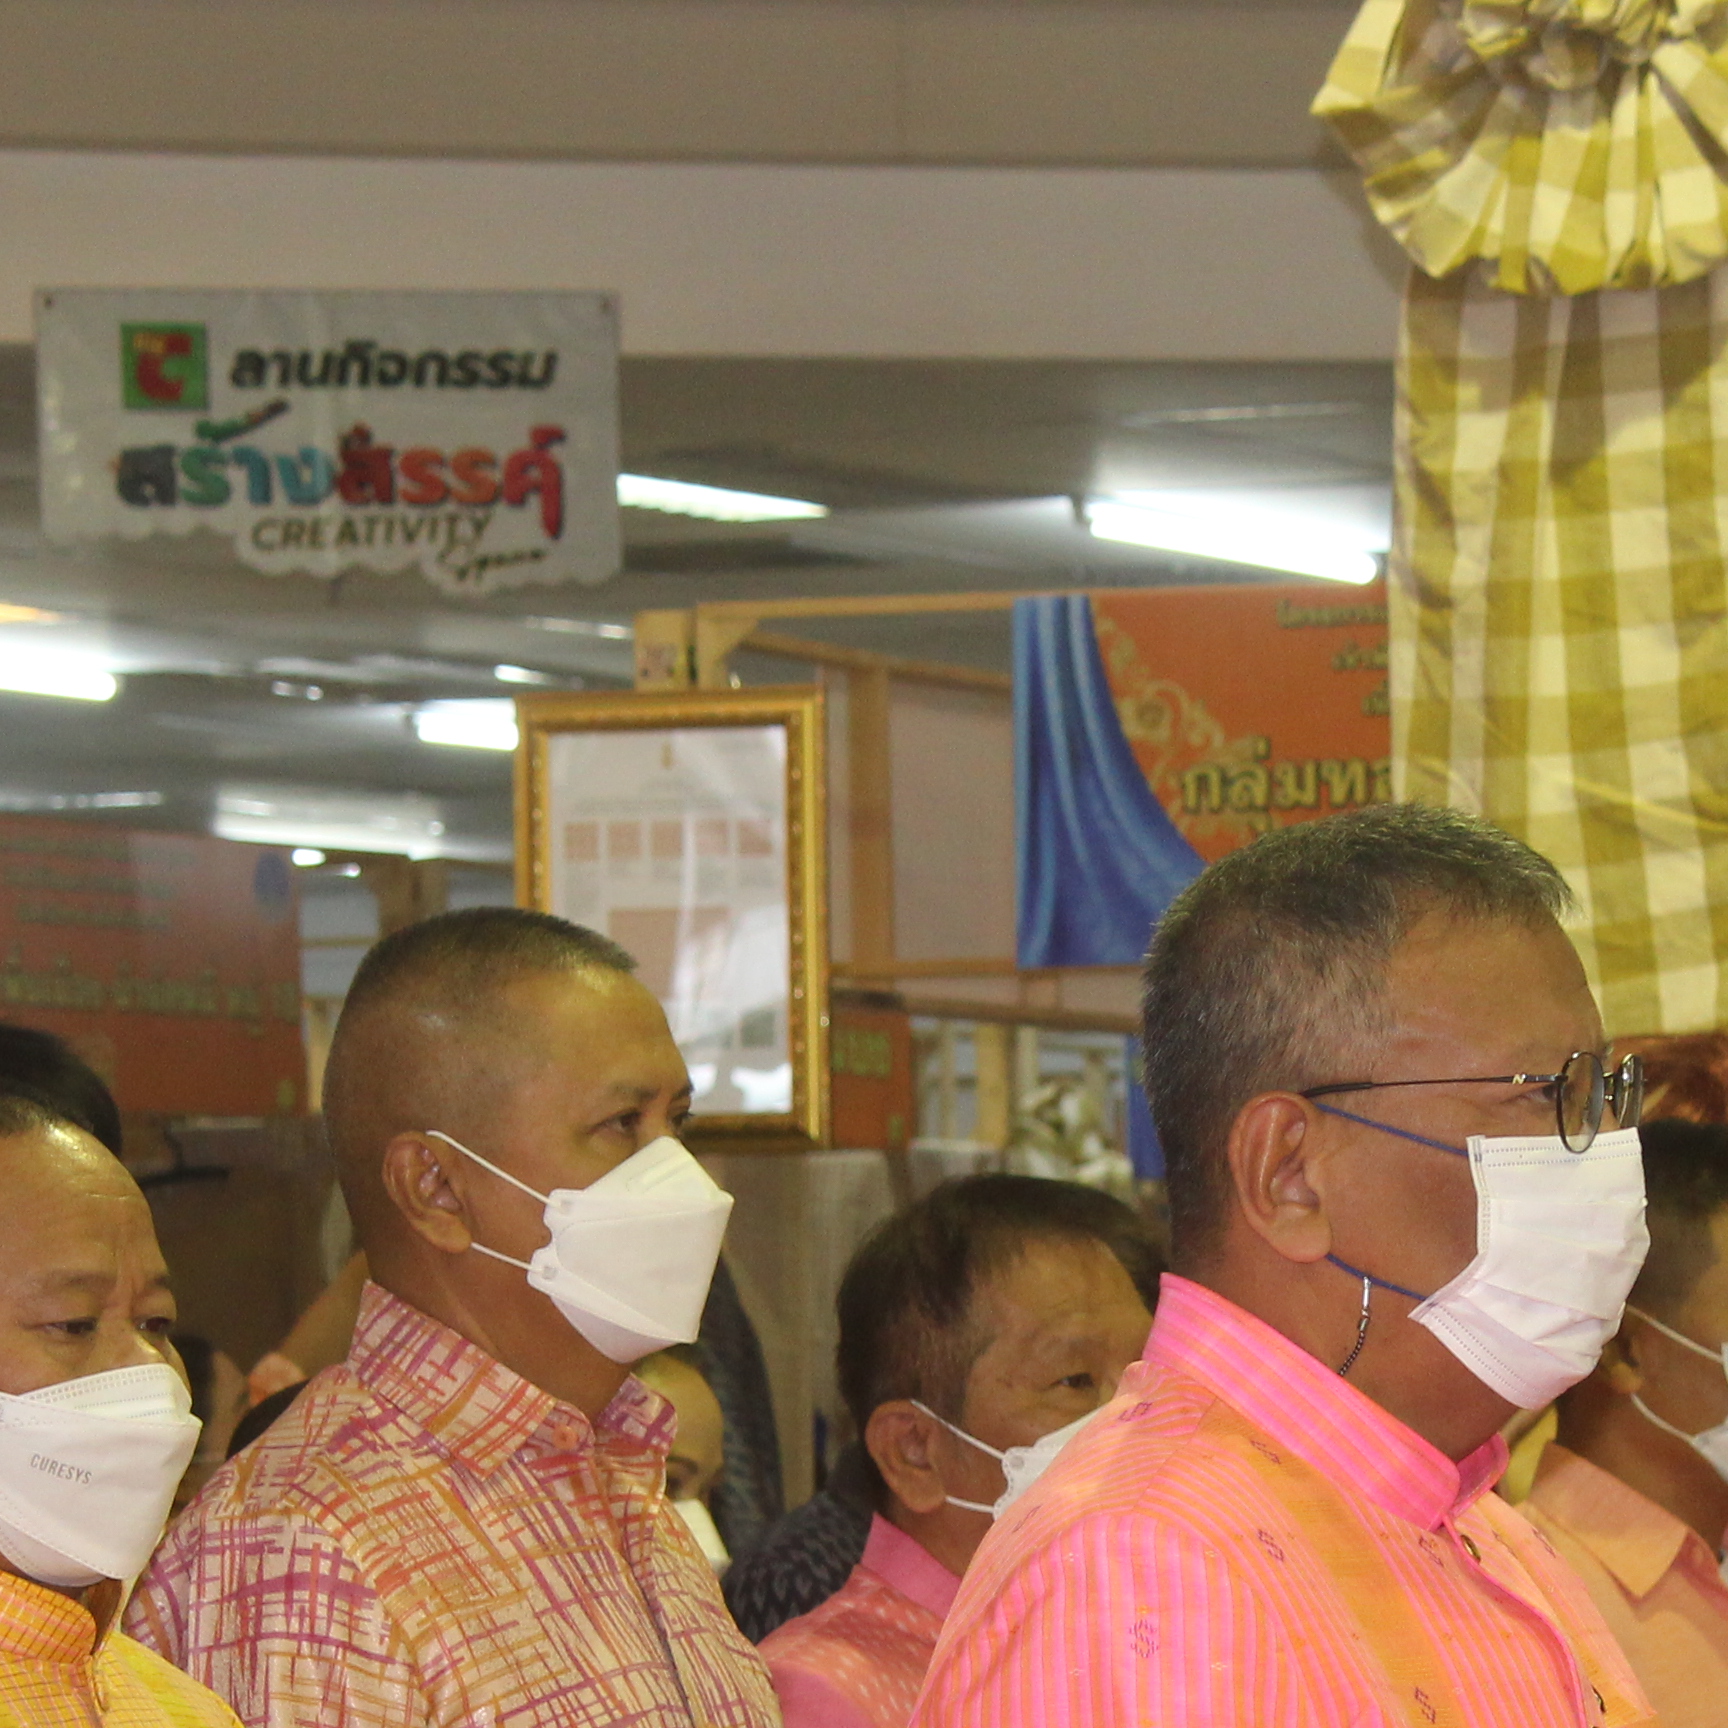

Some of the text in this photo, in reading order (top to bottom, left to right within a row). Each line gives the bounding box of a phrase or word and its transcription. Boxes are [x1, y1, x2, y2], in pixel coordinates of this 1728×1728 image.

[229, 339, 558, 390] ลานกิจกรรม
[112, 397, 567, 540] สร้างสรรค์
[251, 508, 493, 553] CREATIVITY
[30, 1453, 92, 1485] CURESYS
